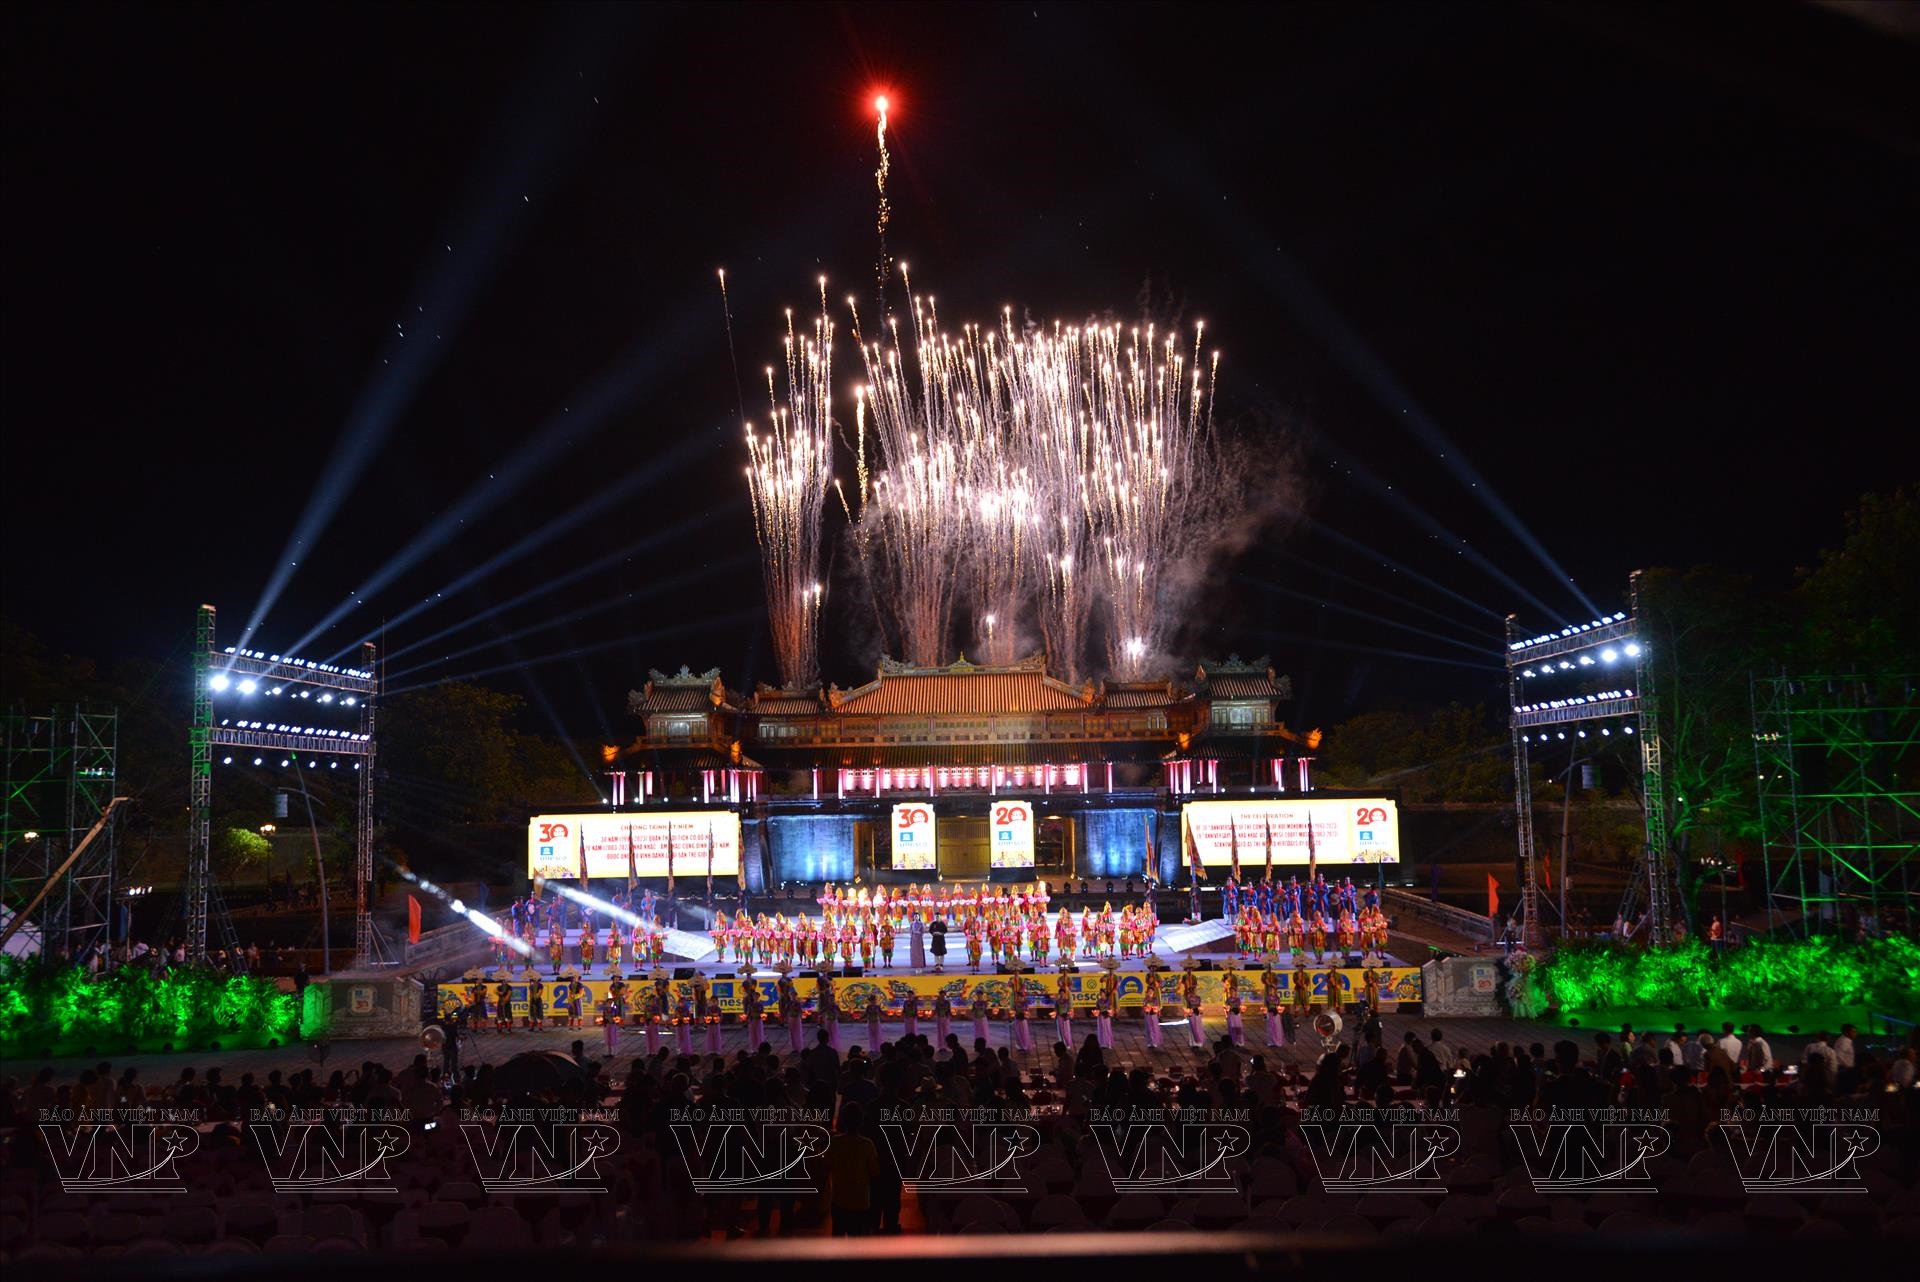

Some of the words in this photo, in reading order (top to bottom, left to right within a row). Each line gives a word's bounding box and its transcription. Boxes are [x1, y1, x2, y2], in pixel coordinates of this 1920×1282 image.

[898, 809, 928, 828] 30
[996, 807, 1027, 825] 20
[1357, 808, 1387, 825] 20
[539, 823, 569, 842] 30
